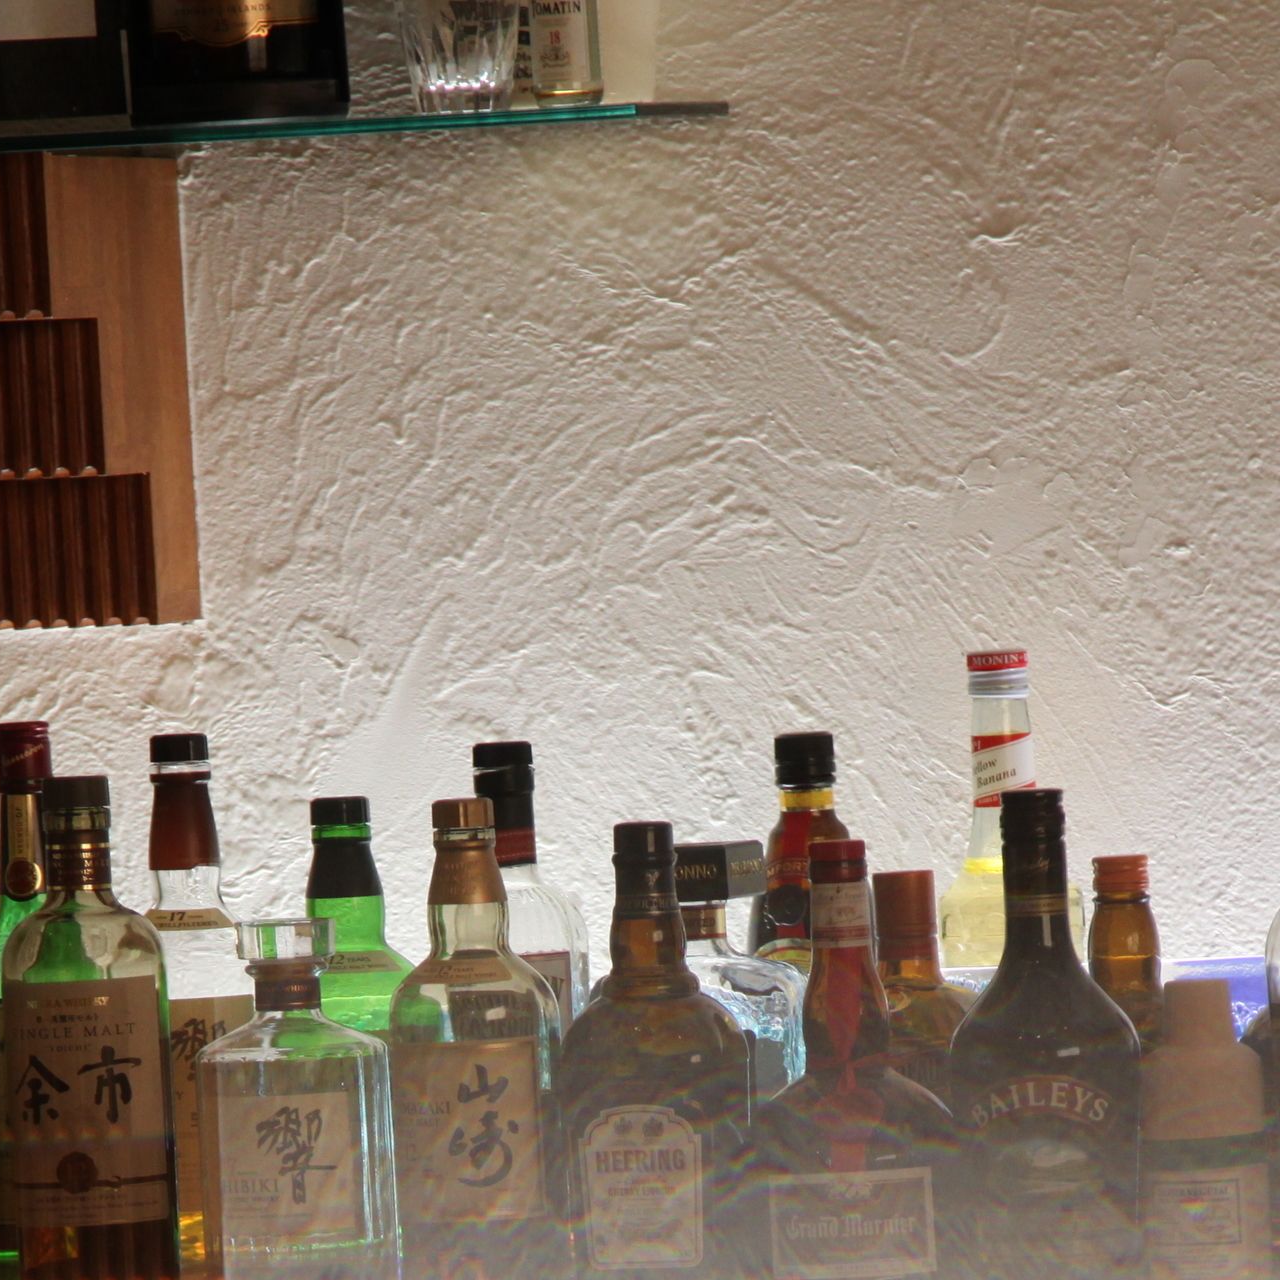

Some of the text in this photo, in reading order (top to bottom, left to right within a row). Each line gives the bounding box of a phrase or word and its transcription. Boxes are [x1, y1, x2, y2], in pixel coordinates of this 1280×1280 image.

[532, 0, 581, 16] TOMATIN
[549, 30, 561, 44] 18
[971, 654, 1021, 667] MONIN
[977, 767, 1017, 788] Banana
[84, 1022, 137, 1038] MALT
[15, 1045, 142, 1125] 余市
[970, 1081, 1110, 1129] BAILEYS
[255, 1105, 339, 1206] 響
[595, 1147, 687, 1174] HEERING
